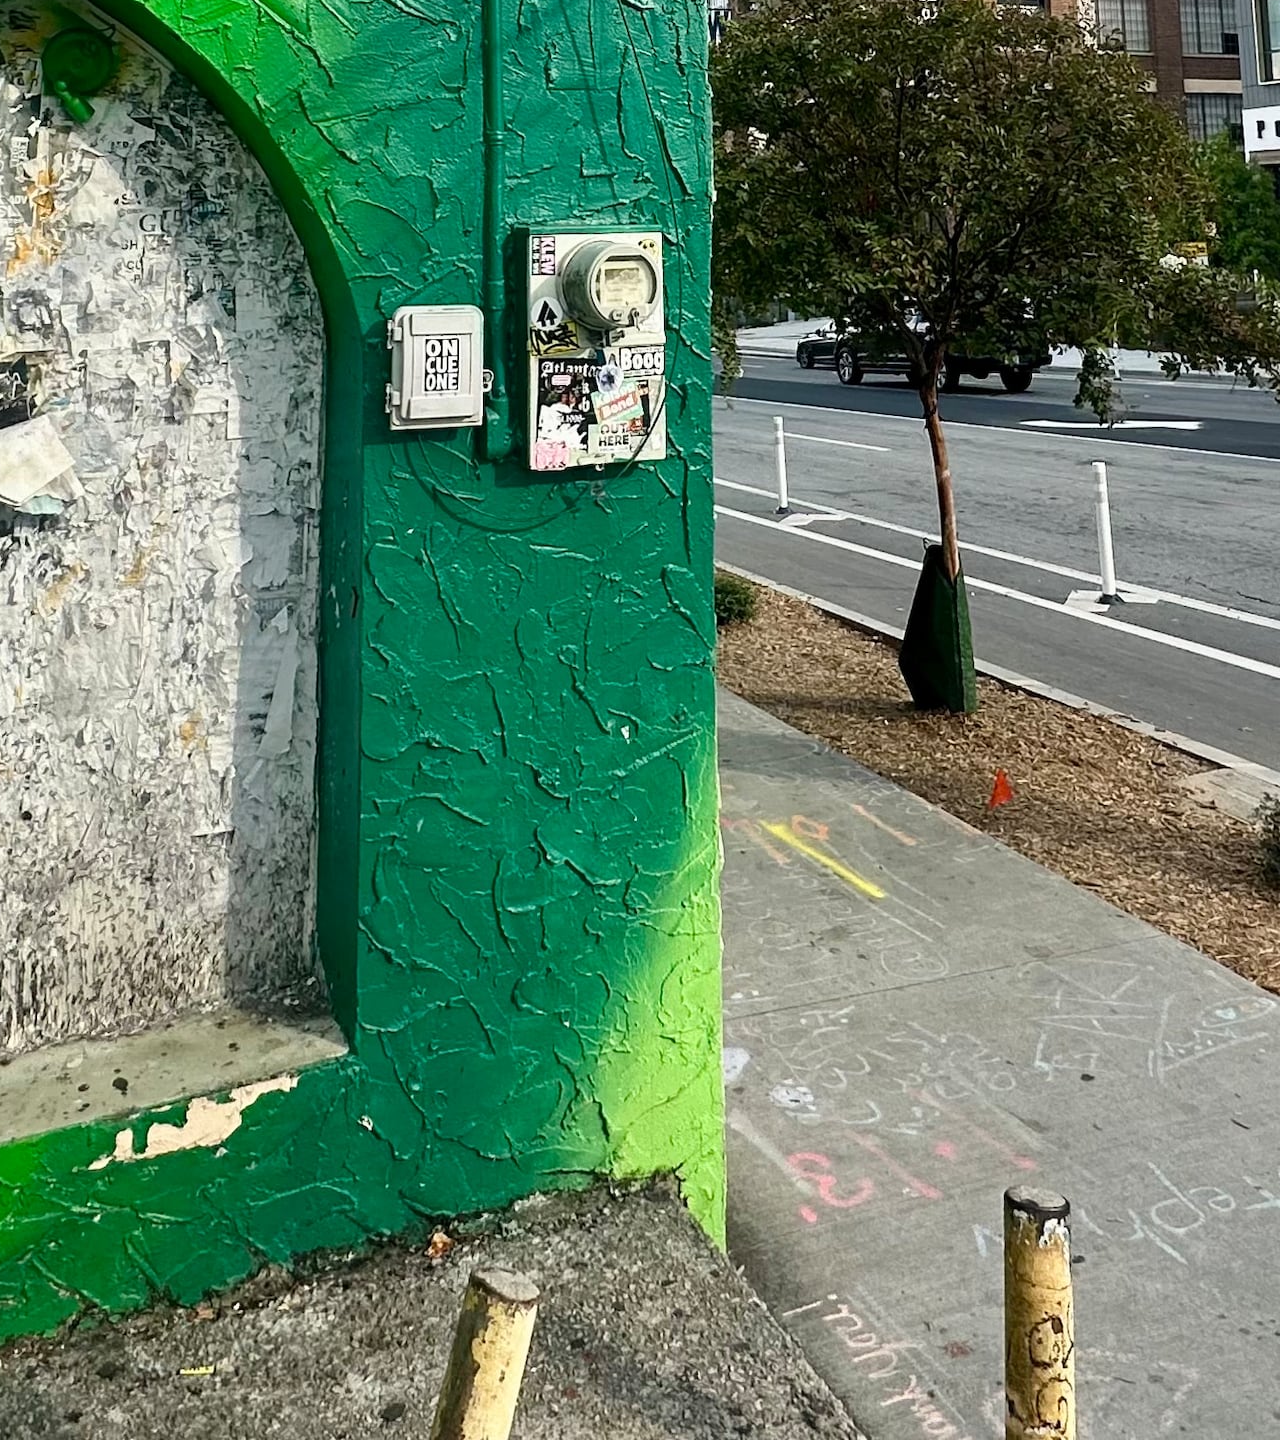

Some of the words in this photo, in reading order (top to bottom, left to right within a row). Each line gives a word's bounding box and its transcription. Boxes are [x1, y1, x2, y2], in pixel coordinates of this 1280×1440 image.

[426, 339, 458, 356] ON
[426, 356, 458, 373] CUE
[425, 373, 458, 391] ONE
[599, 435, 630, 446] HERE
